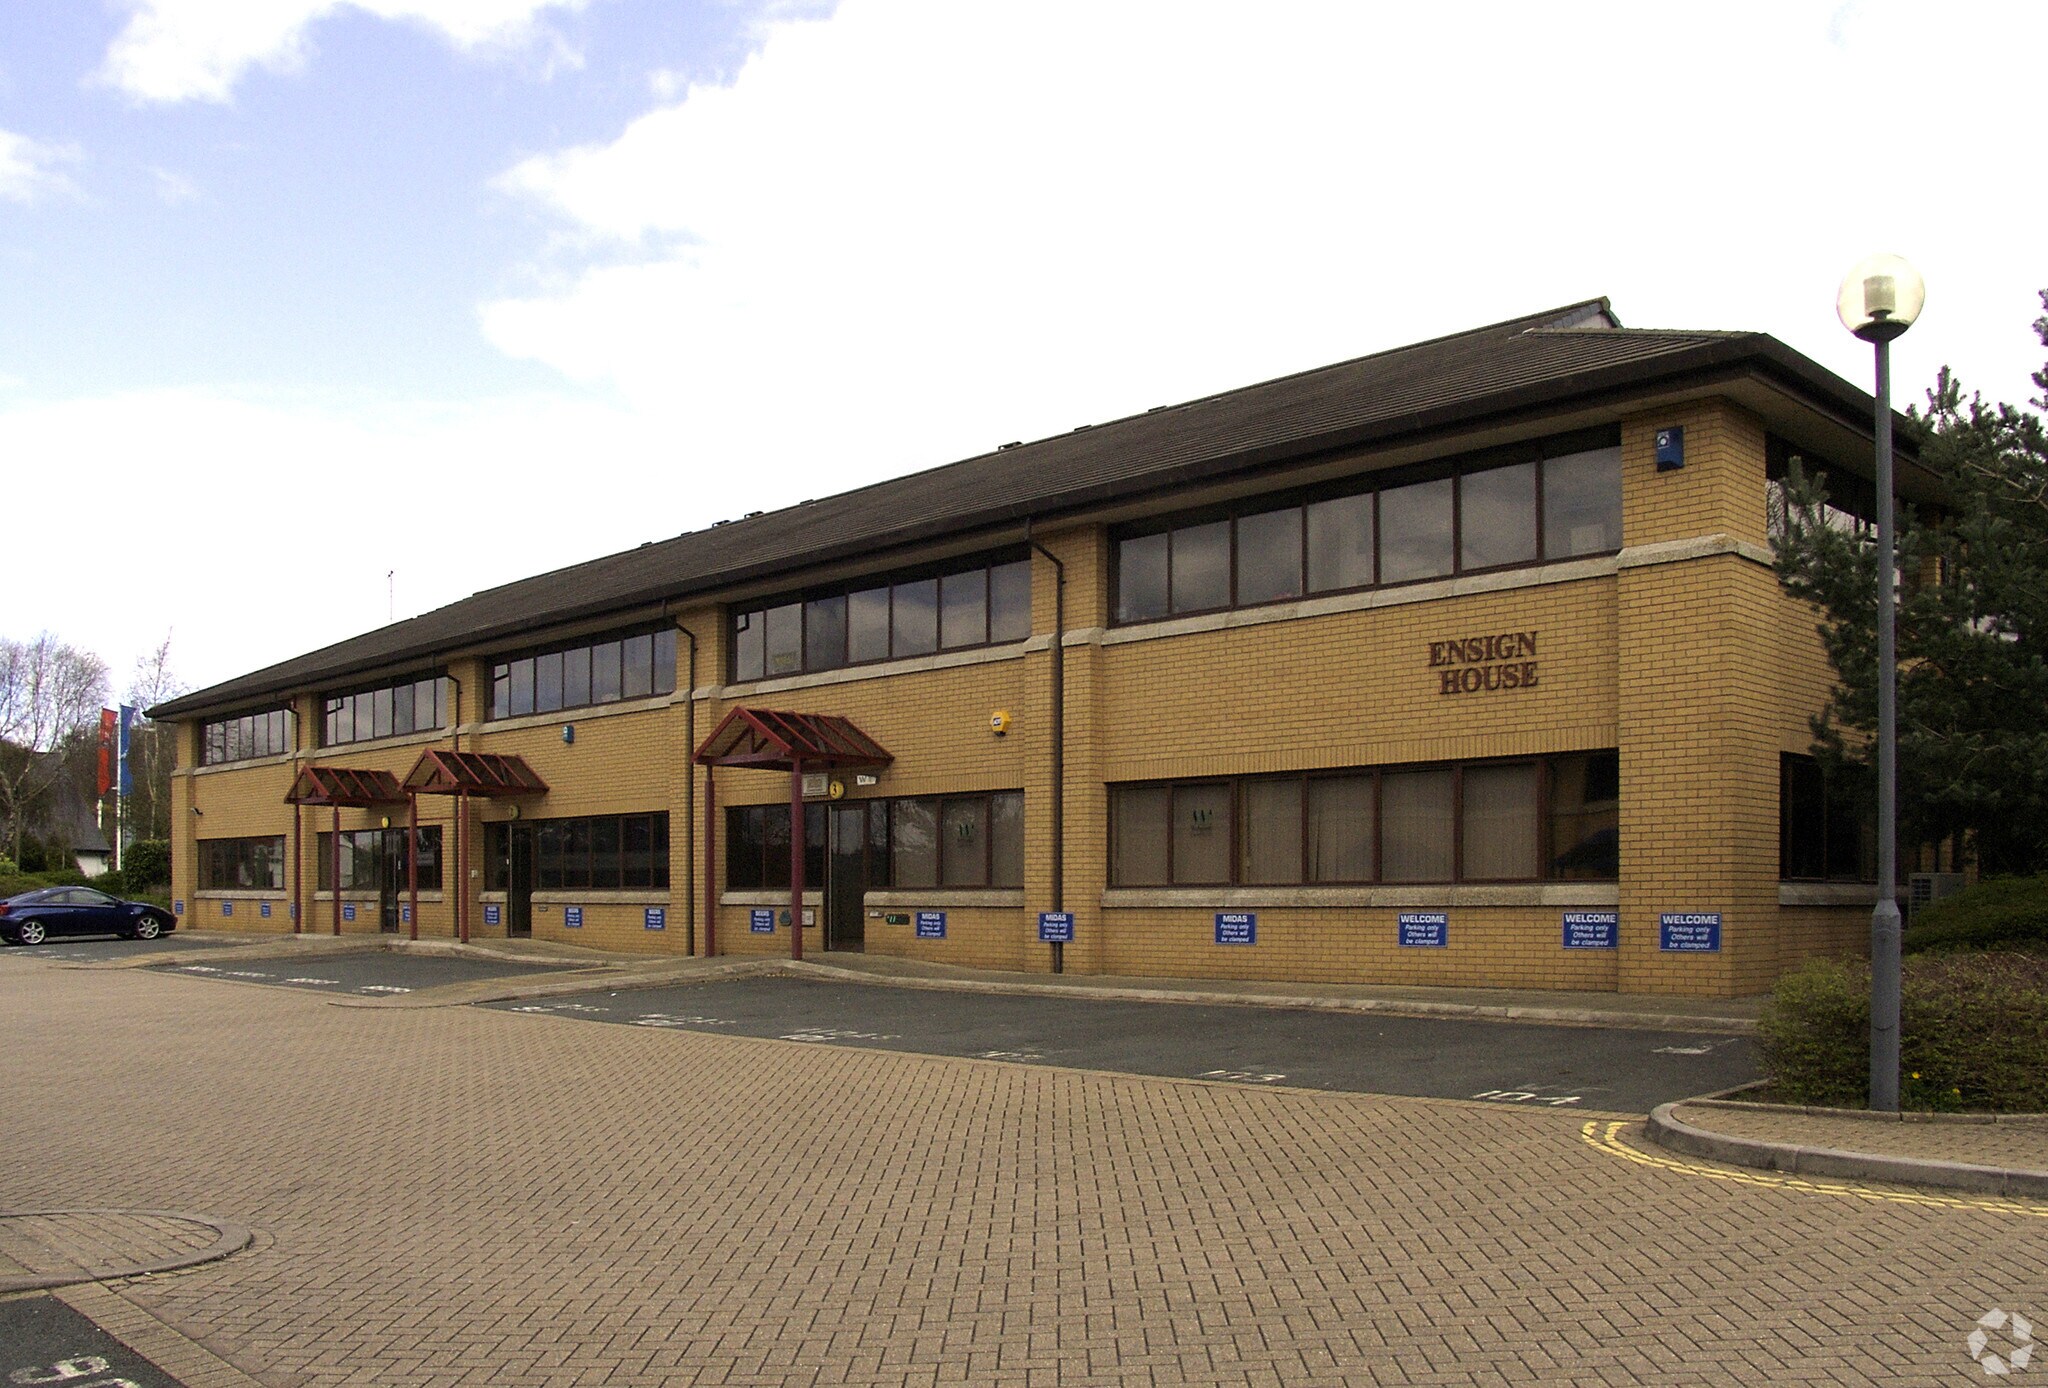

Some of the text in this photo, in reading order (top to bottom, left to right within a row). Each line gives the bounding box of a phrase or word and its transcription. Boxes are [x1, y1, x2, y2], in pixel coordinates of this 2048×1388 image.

[1428, 630, 1539, 667] ENSIGN
[1439, 661, 1539, 694] HOUSE
[1222, 915, 1248, 923] MIDAS
[1400, 914, 1445, 923] WELCOME
[1565, 914, 1616, 923] WELCOME
[1662, 915, 1718, 924] WELCOME
[1668, 925, 1694, 933] Parking
[1680, 941, 1711, 949] clamped
[1471, 1089, 1582, 1105] 104
